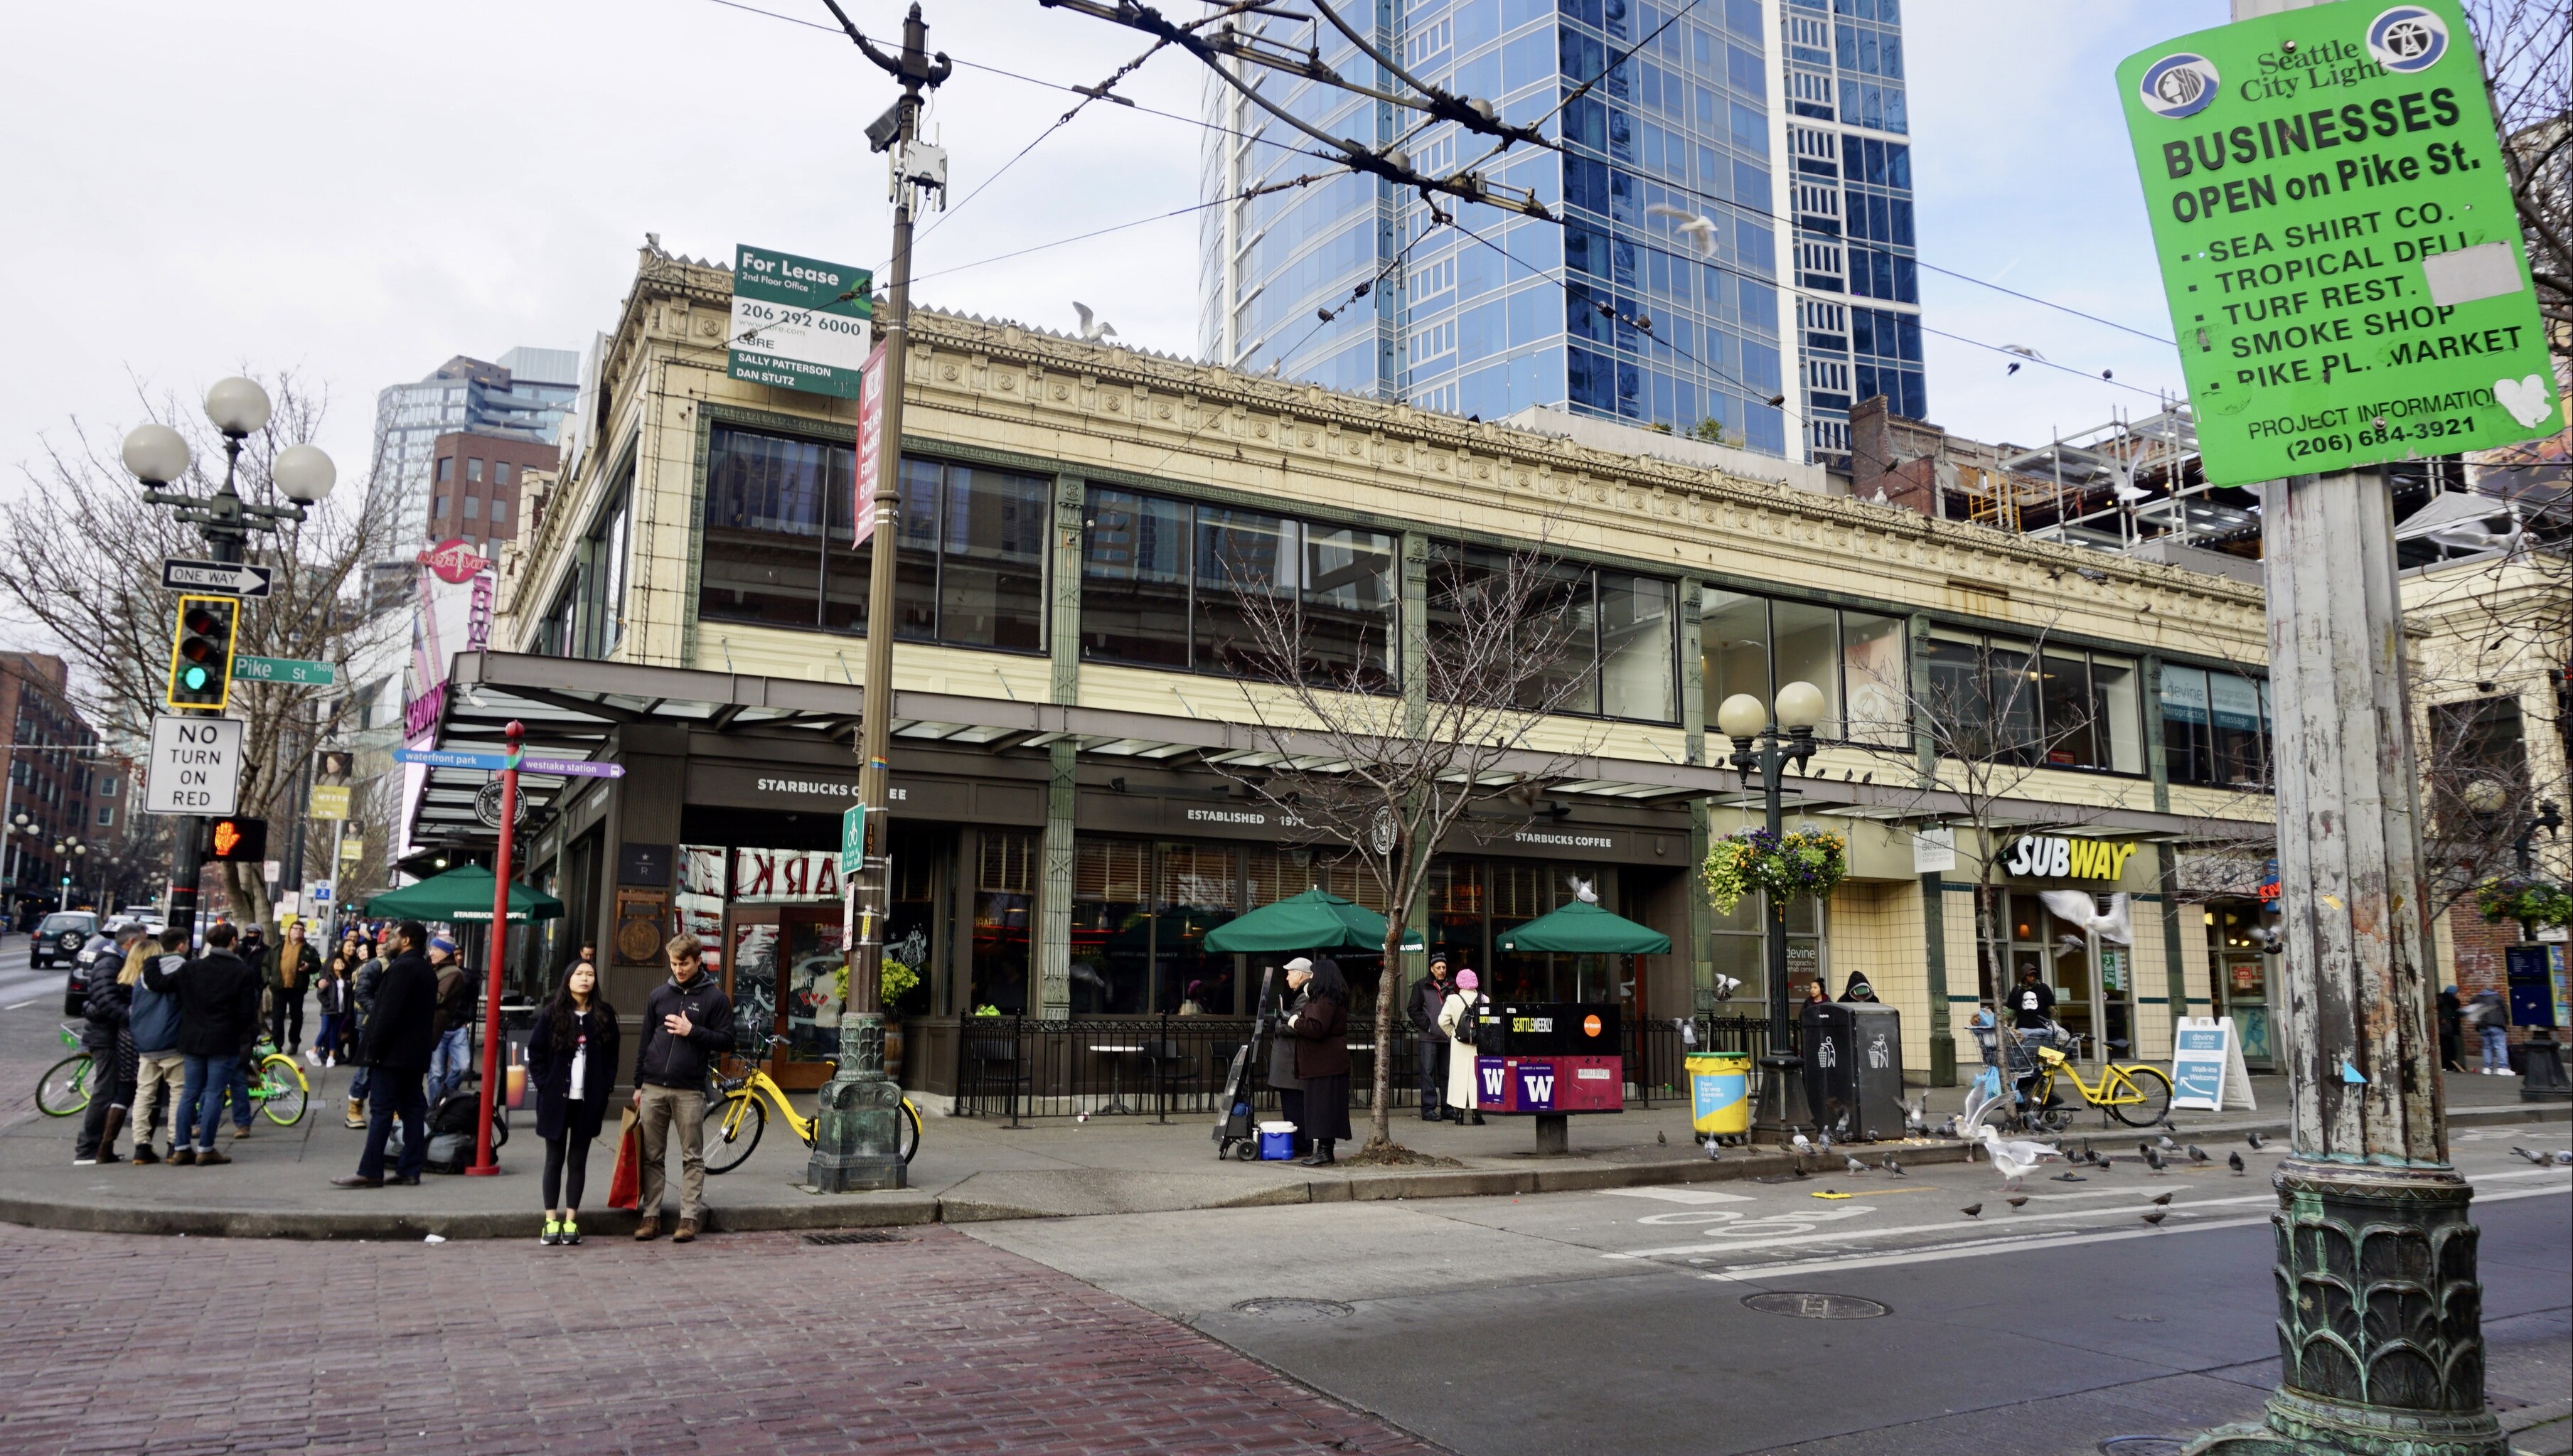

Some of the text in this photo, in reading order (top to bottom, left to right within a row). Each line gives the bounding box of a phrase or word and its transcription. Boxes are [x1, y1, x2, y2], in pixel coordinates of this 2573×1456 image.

[2258, 40, 2359, 77] Seattle
[2240, 56, 2389, 102] City Light
[2163, 87, 2460, 179] BUSINESSES
[2172, 141, 2481, 223] OPEN on Pike St.
[2209, 202, 2454, 262] SEA SHIRT CO.
[742, 252, 839, 286] For Lease
[2215, 247, 2383, 294] TROPICAL
[742, 272, 808, 292] 2nd Floor Office
[2222, 275, 2416, 327] TURF REST.
[742, 304, 860, 336] 206 292 6000
[2231, 304, 2455, 359] SMOKE SHOP
[738, 353, 830, 378] SALLY PATTERSON
[2237, 326, 2523, 390] PIKE PL. MARKET
[737, 368, 795, 386] DAN STUTZ
[863, 414, 872, 437] THE
[2248, 407, 2350, 440] PROJECT
[2286, 416, 2476, 461] (206) 684-3921
[861, 453, 877, 480] FRONT
[860, 483, 865, 500] IS
[174, 569, 237, 586] ONE WAY
[235, 658, 333, 681] Pike St 1500
[2167, 681, 2203, 701] devine
[2220, 714, 2249, 727] massage
[178, 725, 218, 744] NO
[171, 749, 221, 765] TURN
[405, 751, 477, 766] waterfront park
[525, 760, 597, 774] westlake station
[181, 770, 205, 785] ON
[173, 791, 210, 806] RED
[757, 778, 906, 801] STARBUCKS CEE
[1187, 809, 1265, 825] ESTABLISHED
[1515, 833, 1612, 847] STARBUCKS COFFEE
[1922, 839, 1951, 852] devine
[2006, 833, 2139, 882] SUBWAY
[453, 911, 495, 920] STARBUCK
[1786, 946, 1815, 959] devine
[1483, 1069, 1504, 1095] W
[1524, 1076, 1554, 1102] W
